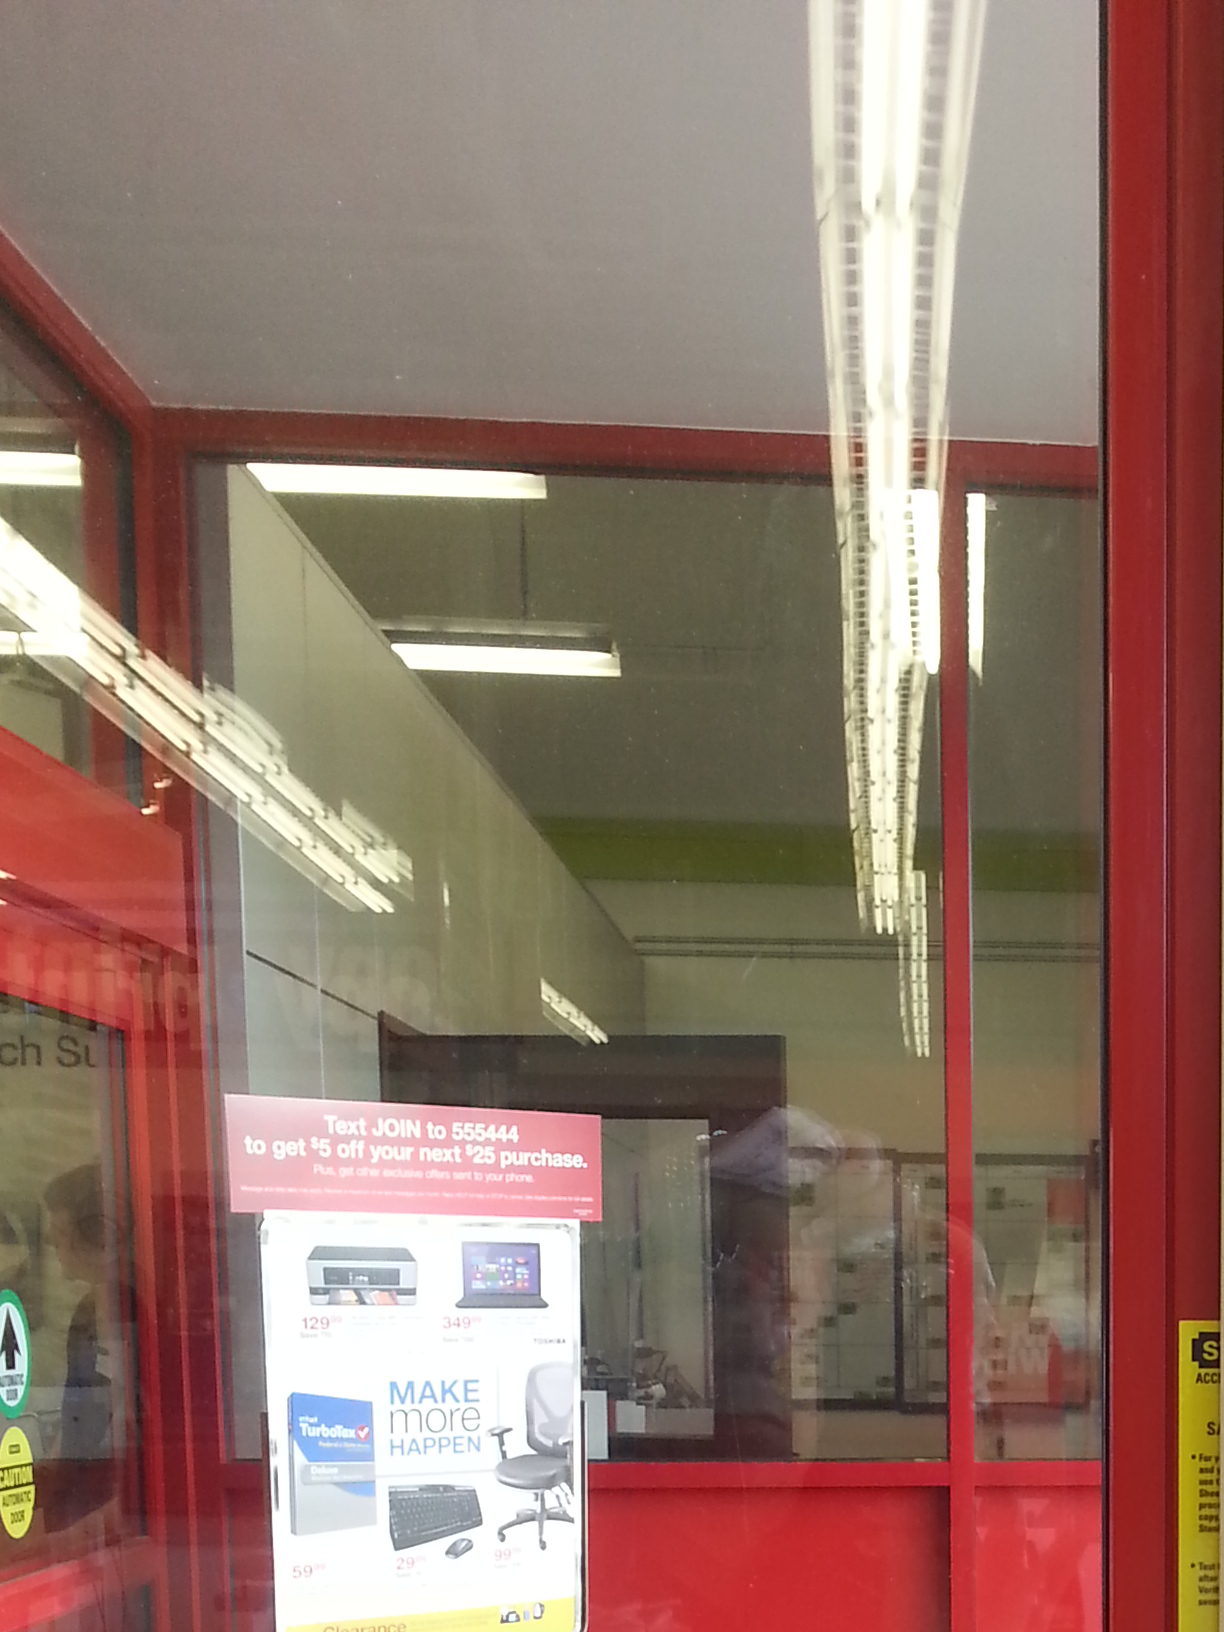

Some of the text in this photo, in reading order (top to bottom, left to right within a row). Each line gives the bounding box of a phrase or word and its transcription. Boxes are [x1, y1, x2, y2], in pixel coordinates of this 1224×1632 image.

[323, 1115, 519, 1143] Text JOIN to 555444
[244, 1136, 588, 1169] to get $5 off your next $25 purchase.
[356, 1167, 379, 1177] other
[389, 1380, 480, 1404] MAKE
[299, 1423, 356, 1439] TurboTax
[389, 1405, 481, 1434] more
[389, 1435, 481, 1456] HAPPEN
